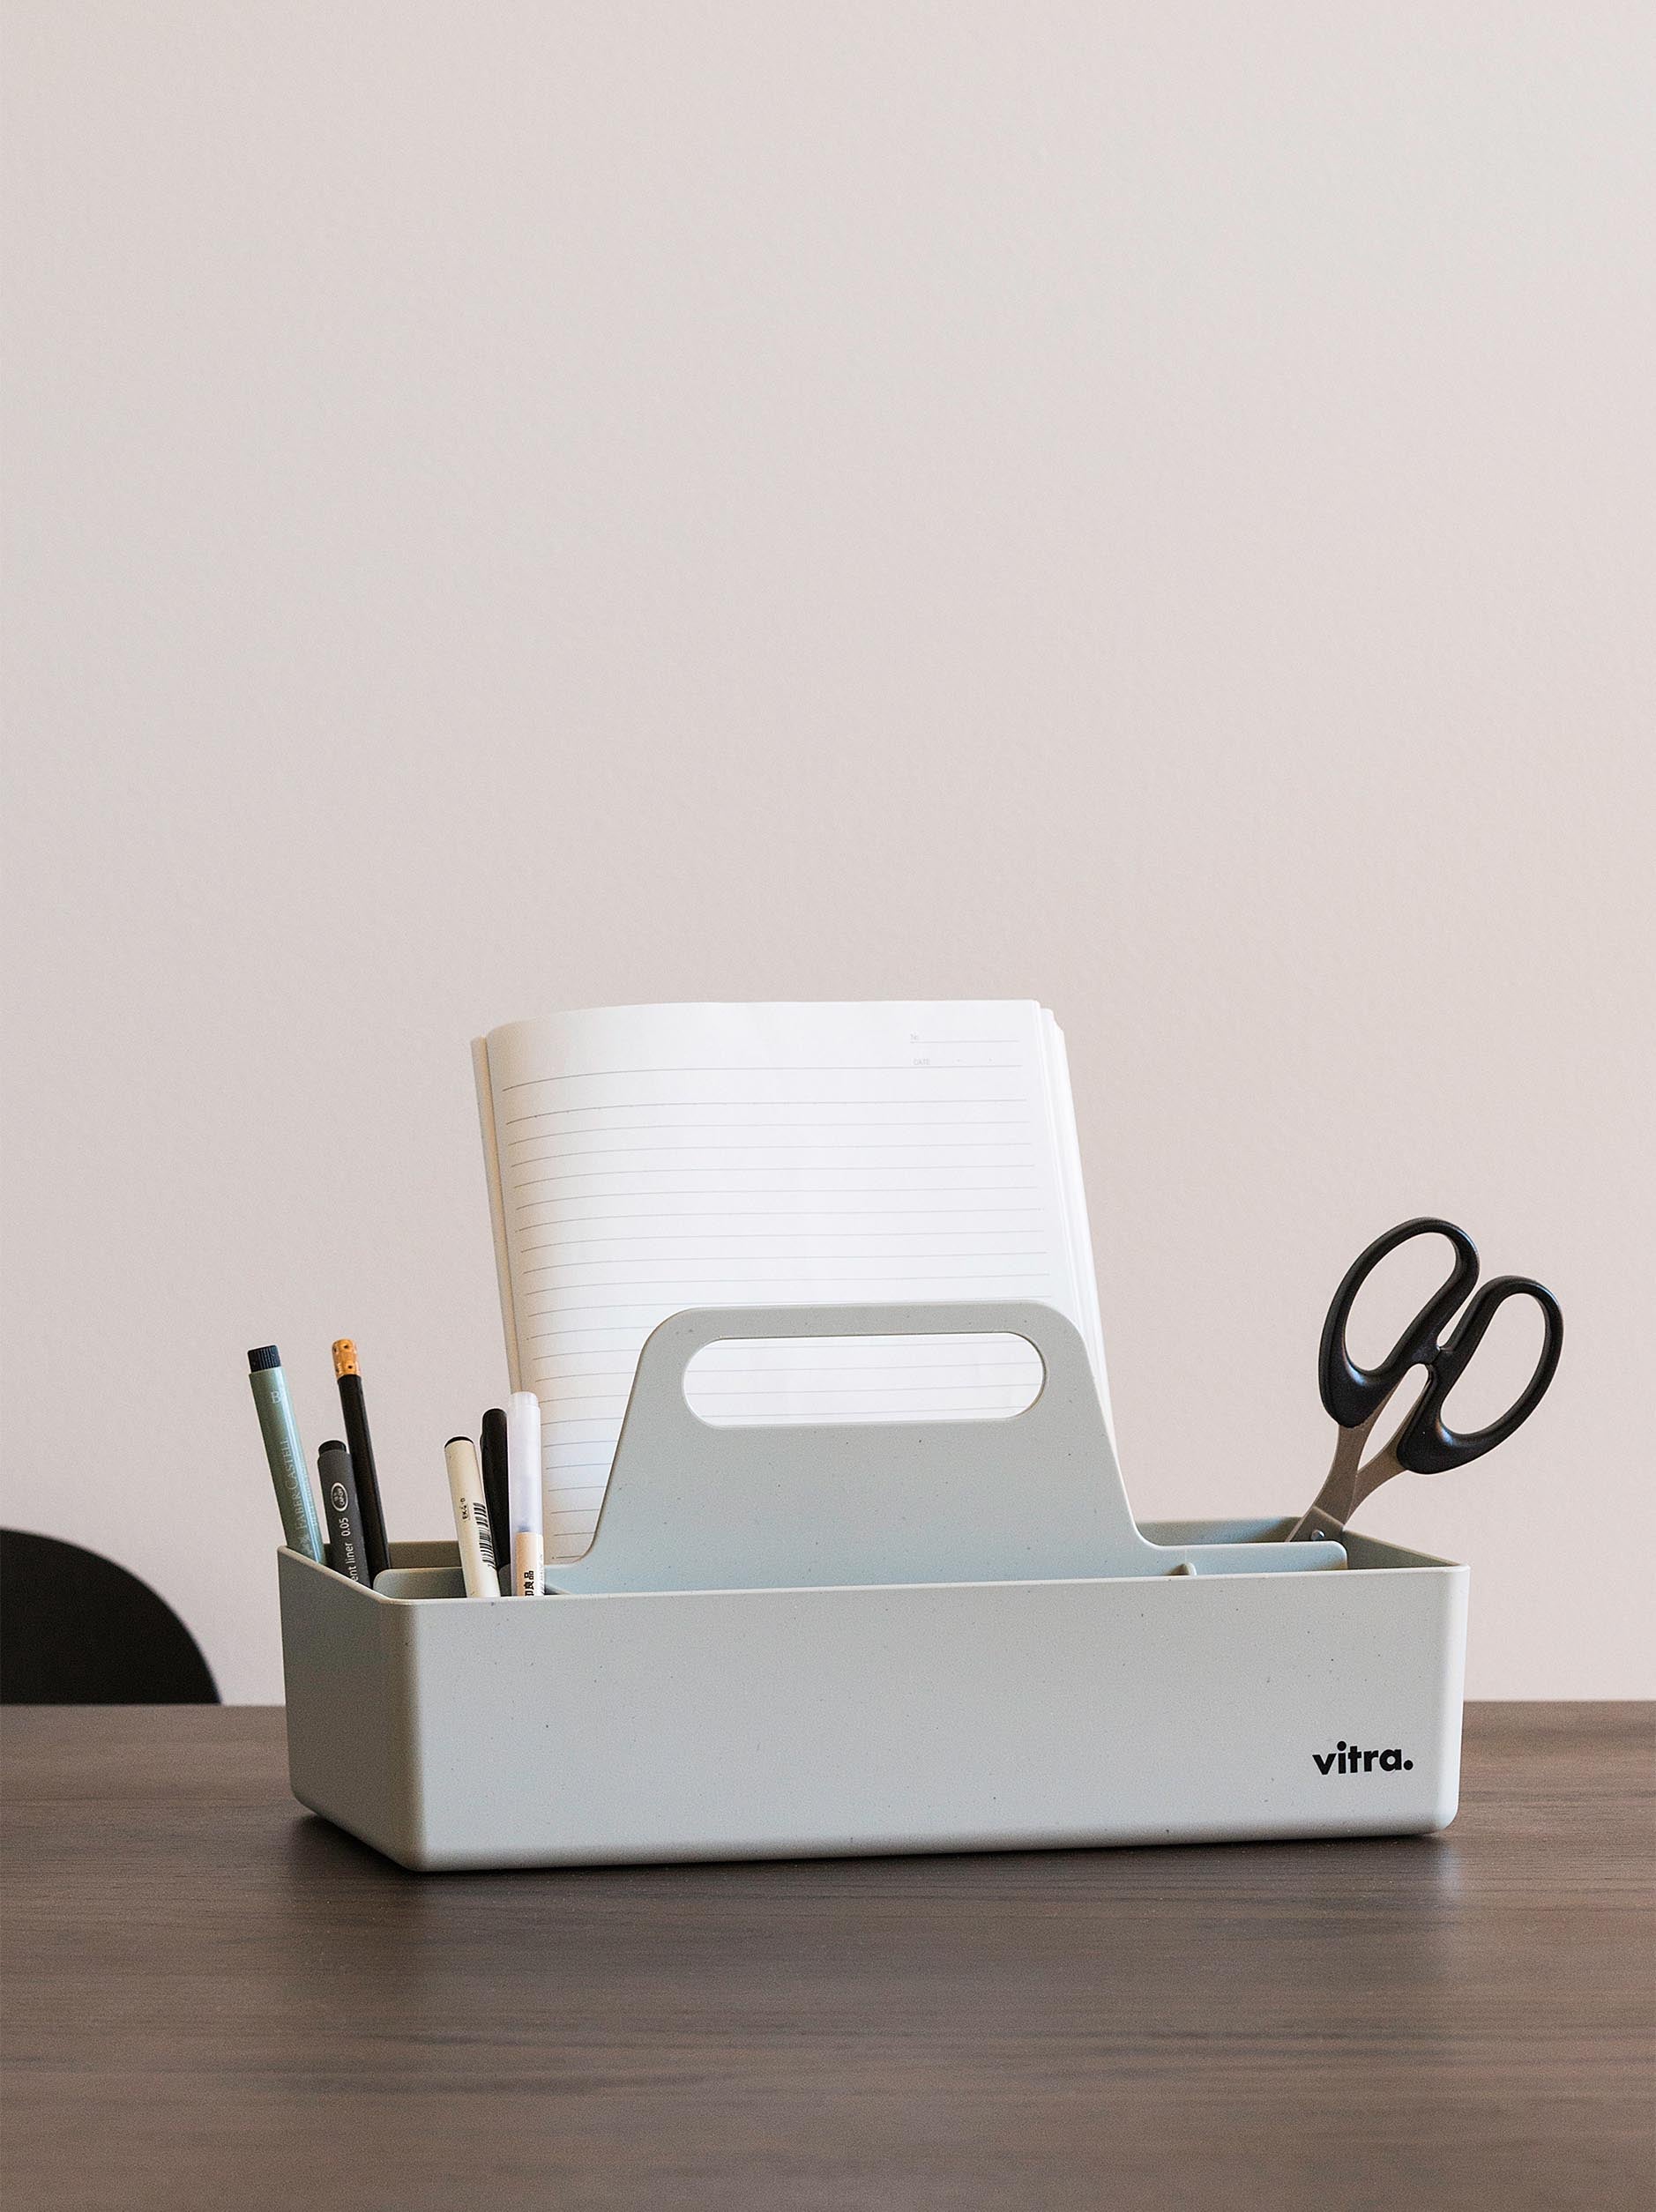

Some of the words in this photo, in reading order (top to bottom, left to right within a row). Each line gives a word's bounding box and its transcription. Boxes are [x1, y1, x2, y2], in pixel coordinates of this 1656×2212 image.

[339, 1517, 352, 1537] 0.05
[344, 1543, 356, 1565] liner
[1312, 1740, 1414, 1776] vitra.
